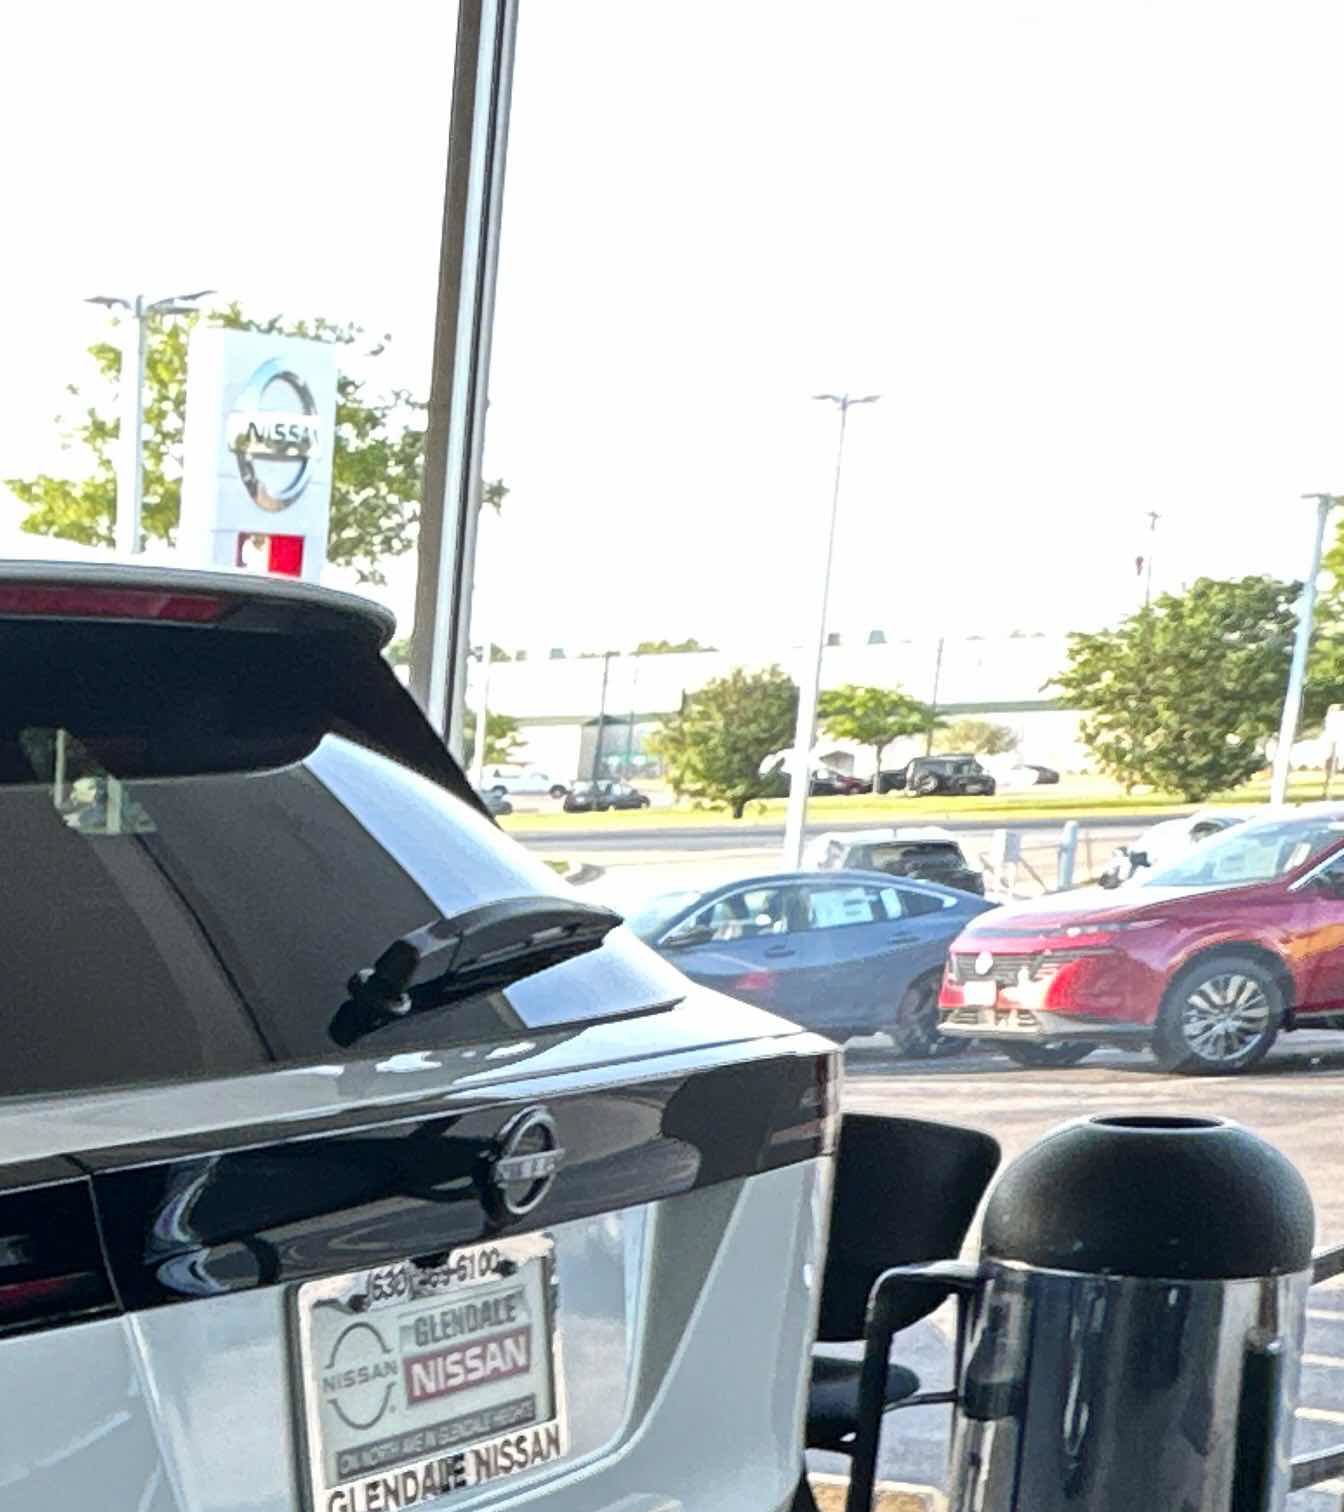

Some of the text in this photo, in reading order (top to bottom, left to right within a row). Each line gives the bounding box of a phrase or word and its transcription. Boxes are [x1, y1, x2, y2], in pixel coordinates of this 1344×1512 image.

[414, 1294, 516, 1348] GLENDALE
[322, 1358, 398, 1393] NISSAN
[411, 1333, 528, 1397] NISSAN
[474, 1423, 561, 1482] NISSAN
